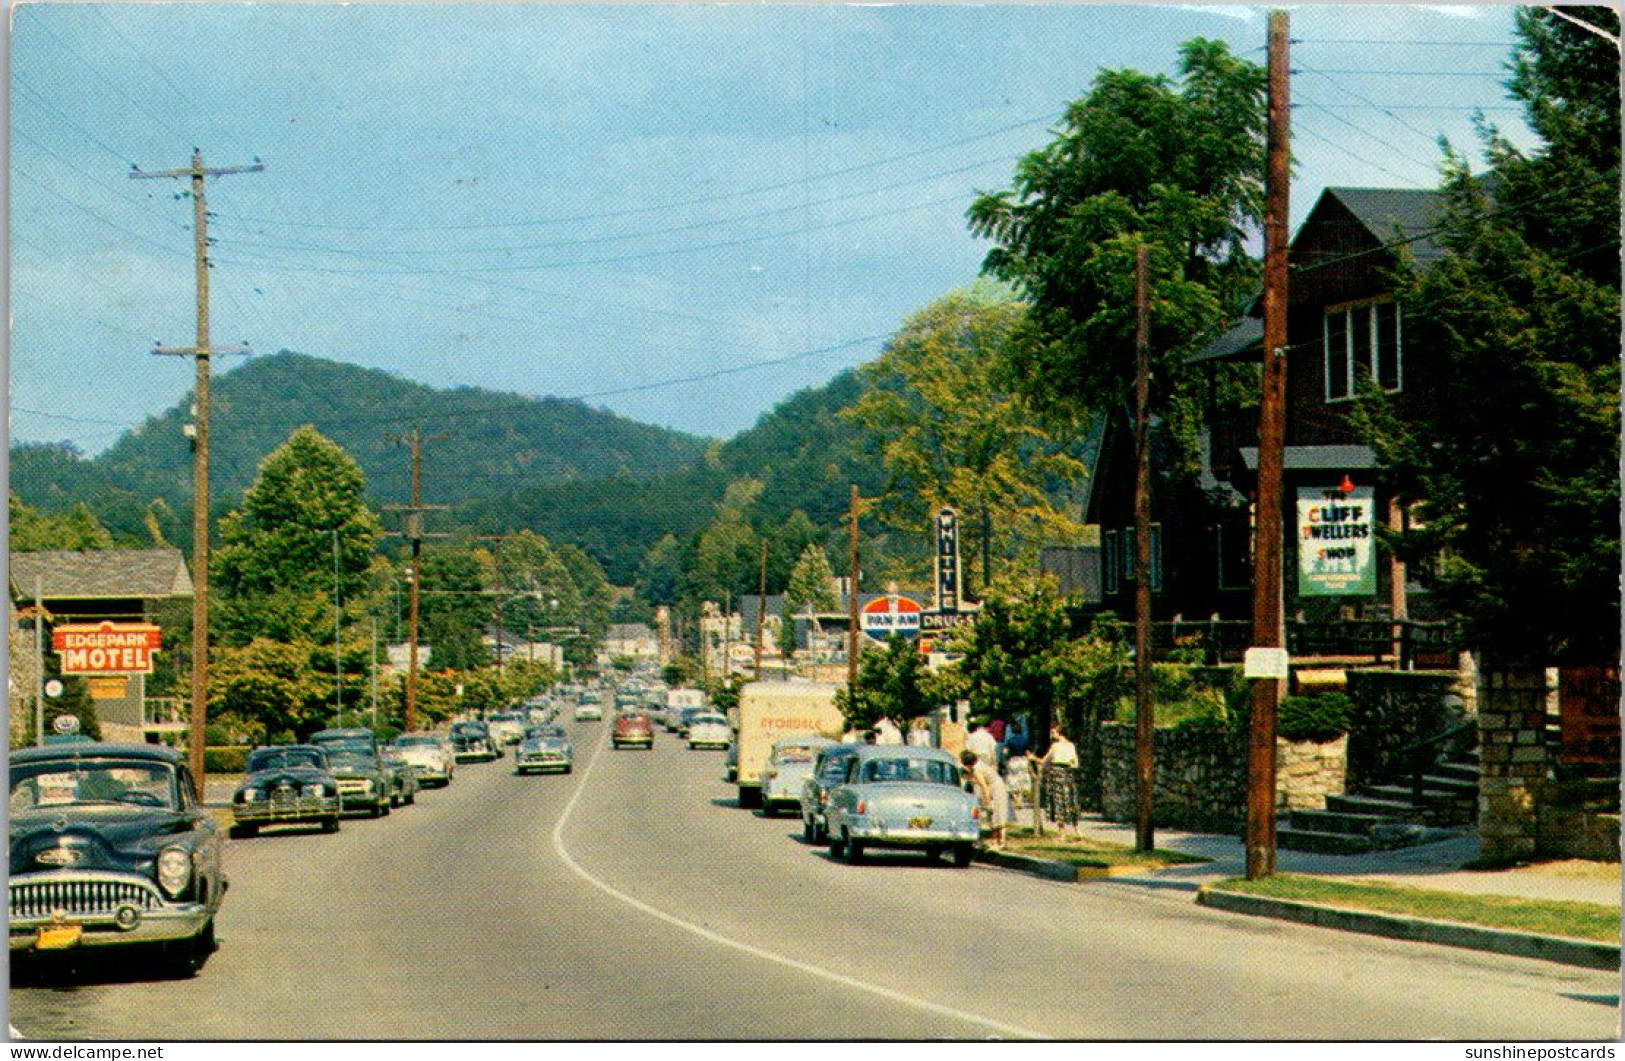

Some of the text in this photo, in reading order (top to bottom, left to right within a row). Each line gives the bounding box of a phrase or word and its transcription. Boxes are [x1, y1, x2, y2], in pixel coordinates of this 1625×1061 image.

[1308, 505, 1363, 522] CLIFF
[940, 513, 955, 608] WHITTLE
[1318, 546, 1356, 560] SHOP
[65, 633, 148, 647] EDGEPARK
[68, 648, 148, 669] MOTEL
